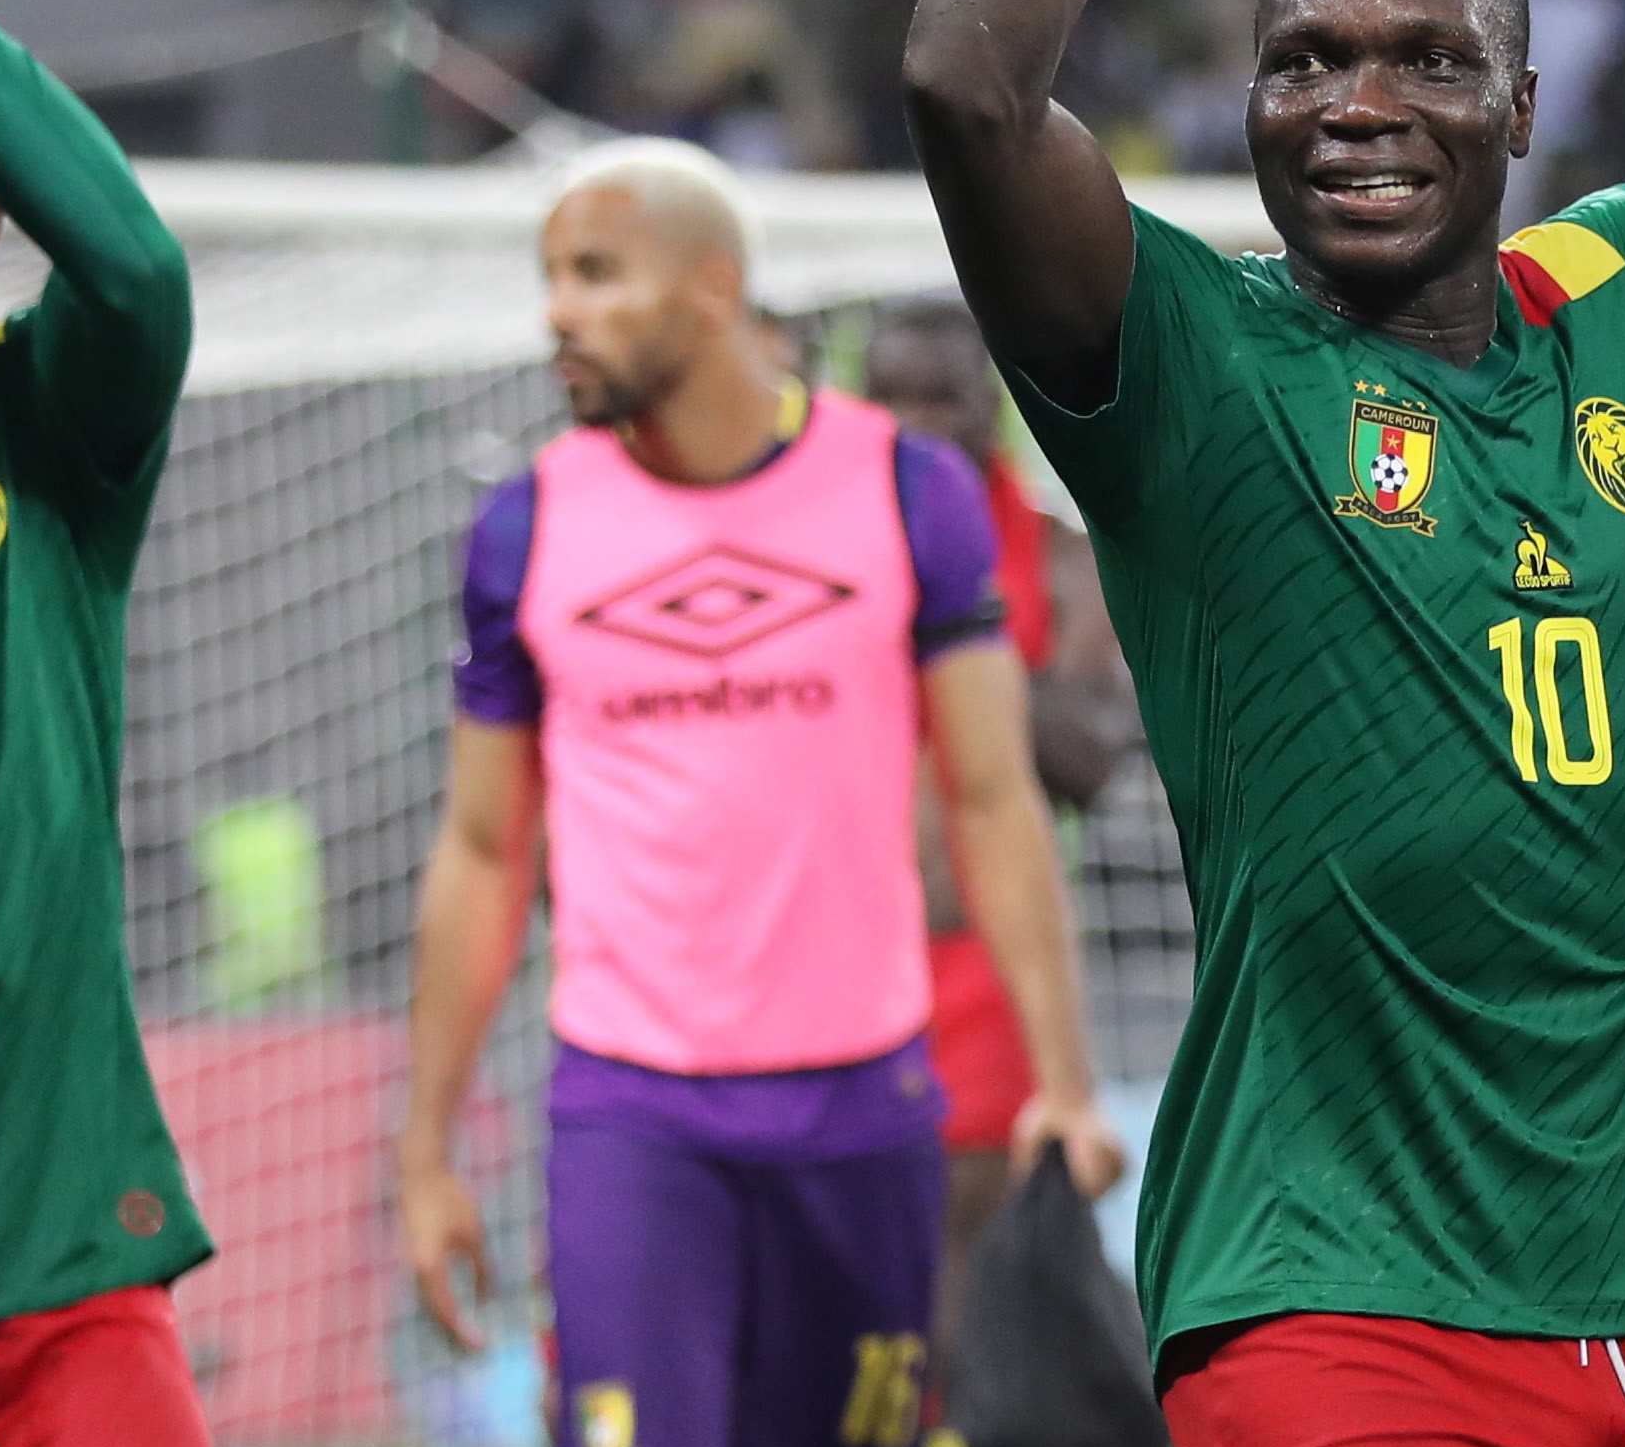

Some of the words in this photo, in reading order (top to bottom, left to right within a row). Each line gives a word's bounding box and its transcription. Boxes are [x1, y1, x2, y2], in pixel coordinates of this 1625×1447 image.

[1360, 406, 1431, 432] CAMEROUN
[600, 668, 837, 725] umbro
[1488, 616, 1614, 786] 10
